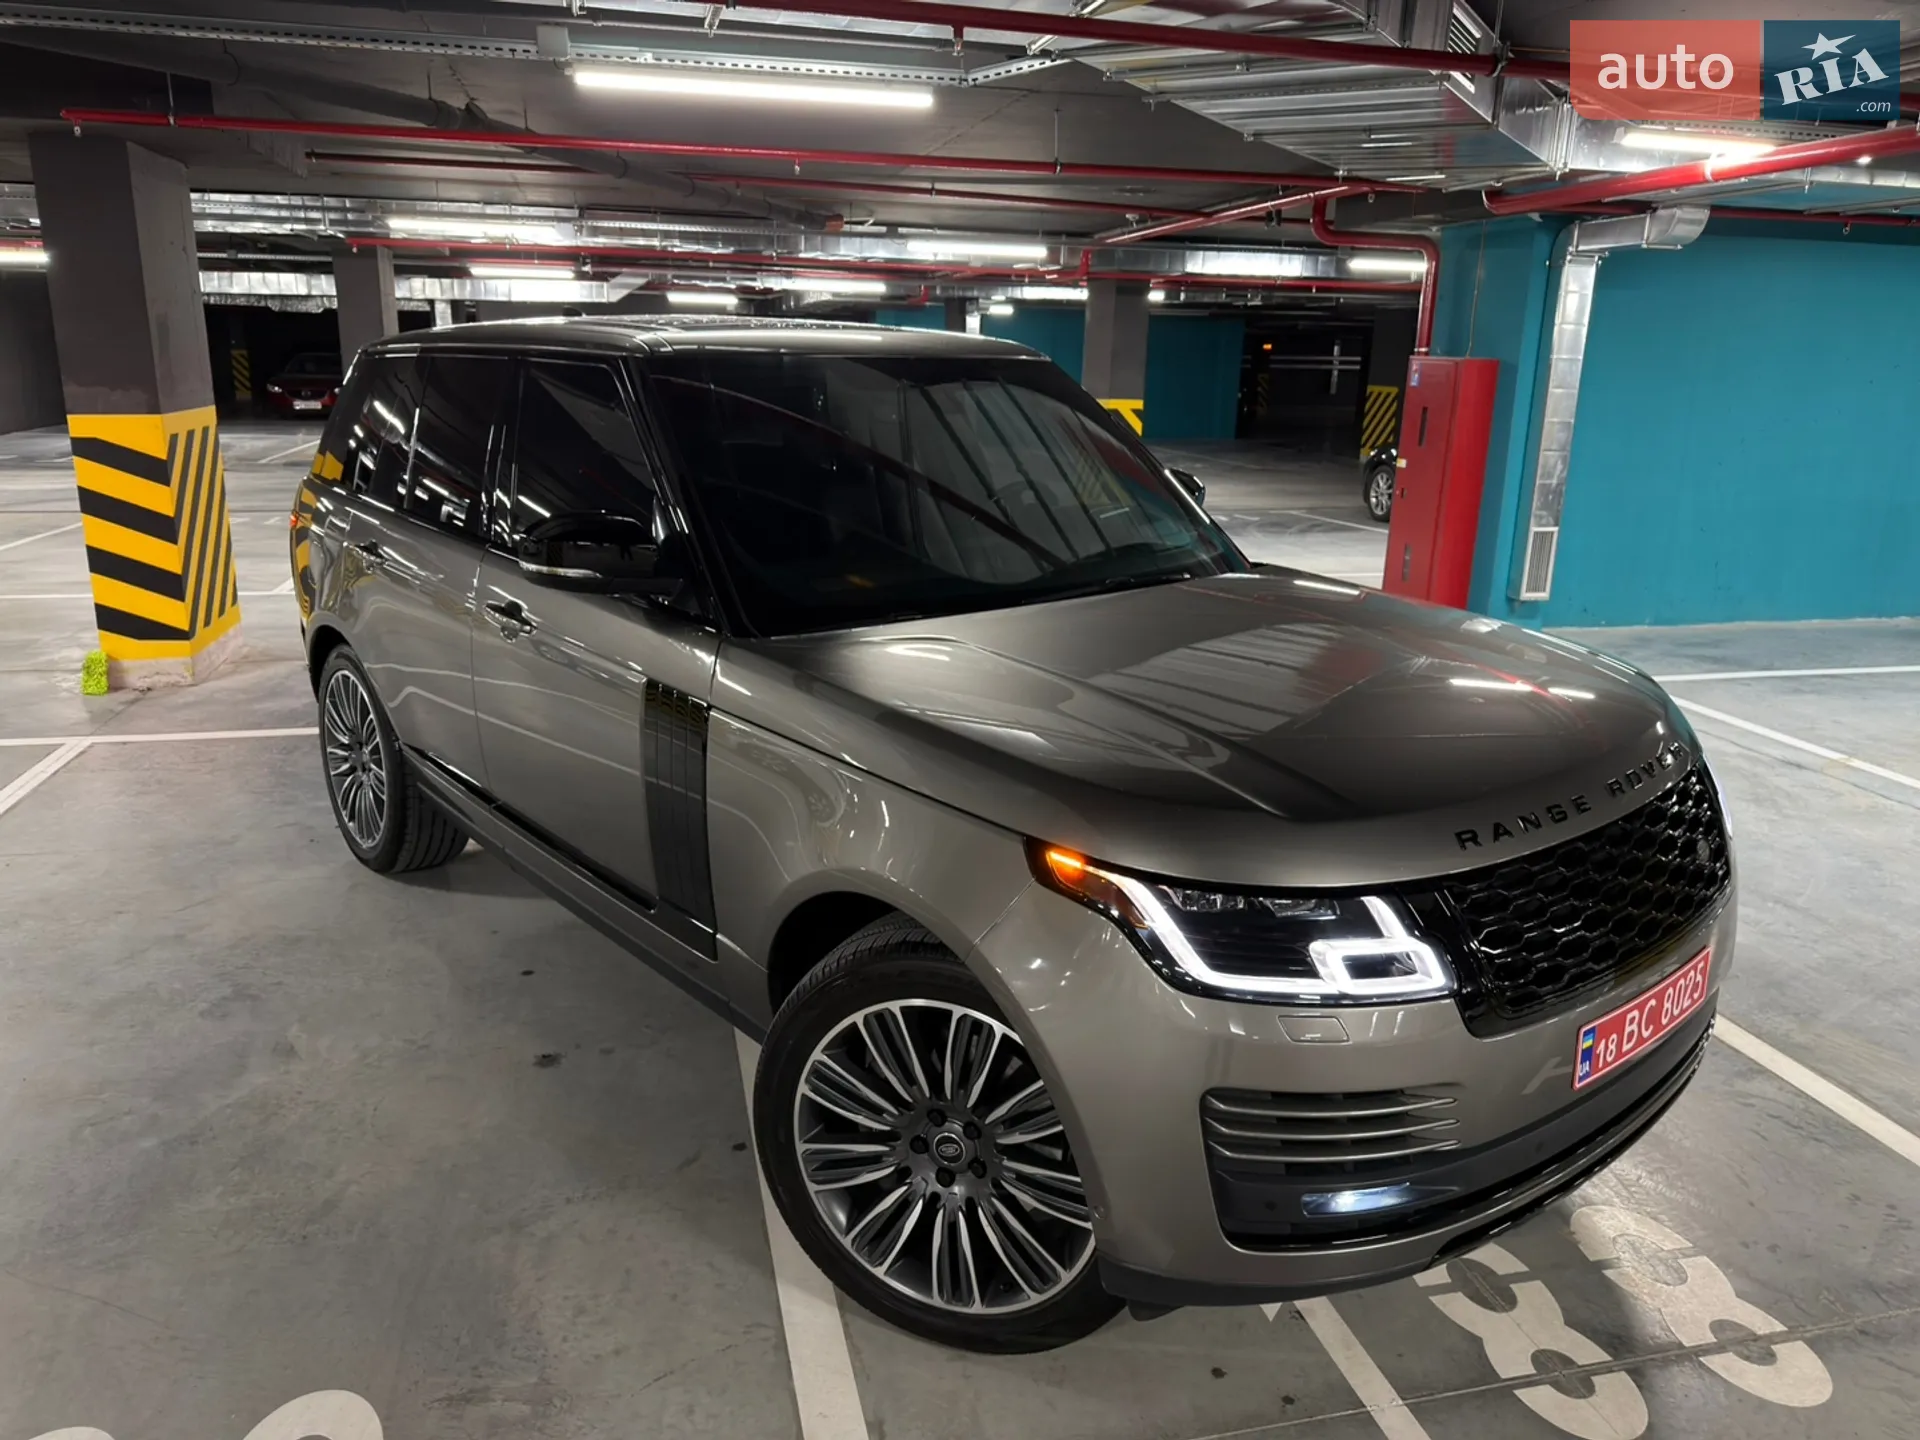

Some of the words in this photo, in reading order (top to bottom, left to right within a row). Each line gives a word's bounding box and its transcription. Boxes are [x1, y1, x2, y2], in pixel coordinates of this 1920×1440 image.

[1454, 795, 1592, 851] RANGE
[1606, 741, 1684, 797] ROVER
[1579, 1060, 1590, 1076] UA
[1596, 1034, 1618, 1068] 18
[1622, 999, 1656, 1053] BC
[1661, 961, 1705, 1025] 8025
